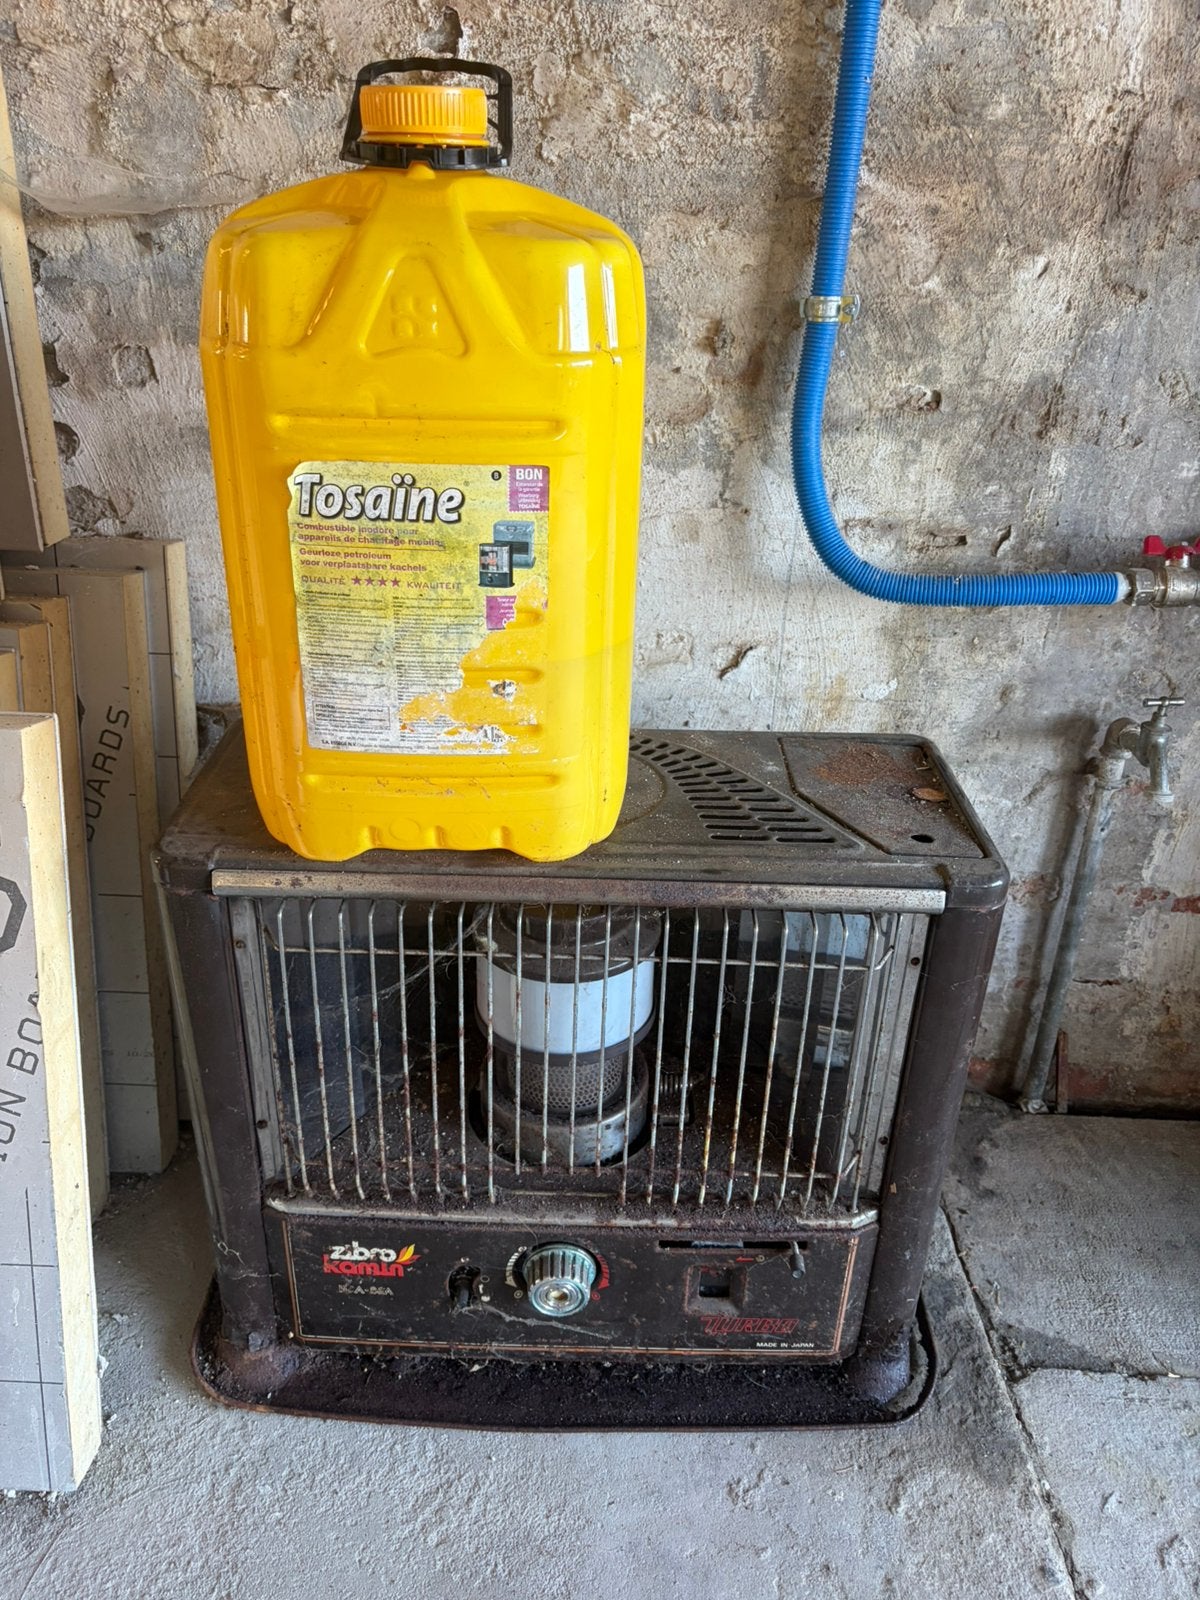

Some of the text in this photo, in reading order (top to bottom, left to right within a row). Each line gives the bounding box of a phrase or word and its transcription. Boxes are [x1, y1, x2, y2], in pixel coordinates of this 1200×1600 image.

[515, 468, 543, 480] BON
[294, 473, 465, 523] Tosaïne
[296, 522, 356, 533] Combustible
[358, 525, 394, 537] inodore
[297, 533, 342, 543] appareils
[344, 535, 356, 543] de
[299, 547, 392, 561] Geurloze petroleum
[300, 559, 427, 573] voor verplaatsbare kachels
[406, 581, 461, 590] KWALITEIT
[700, 1316, 799, 1337] TURBO
